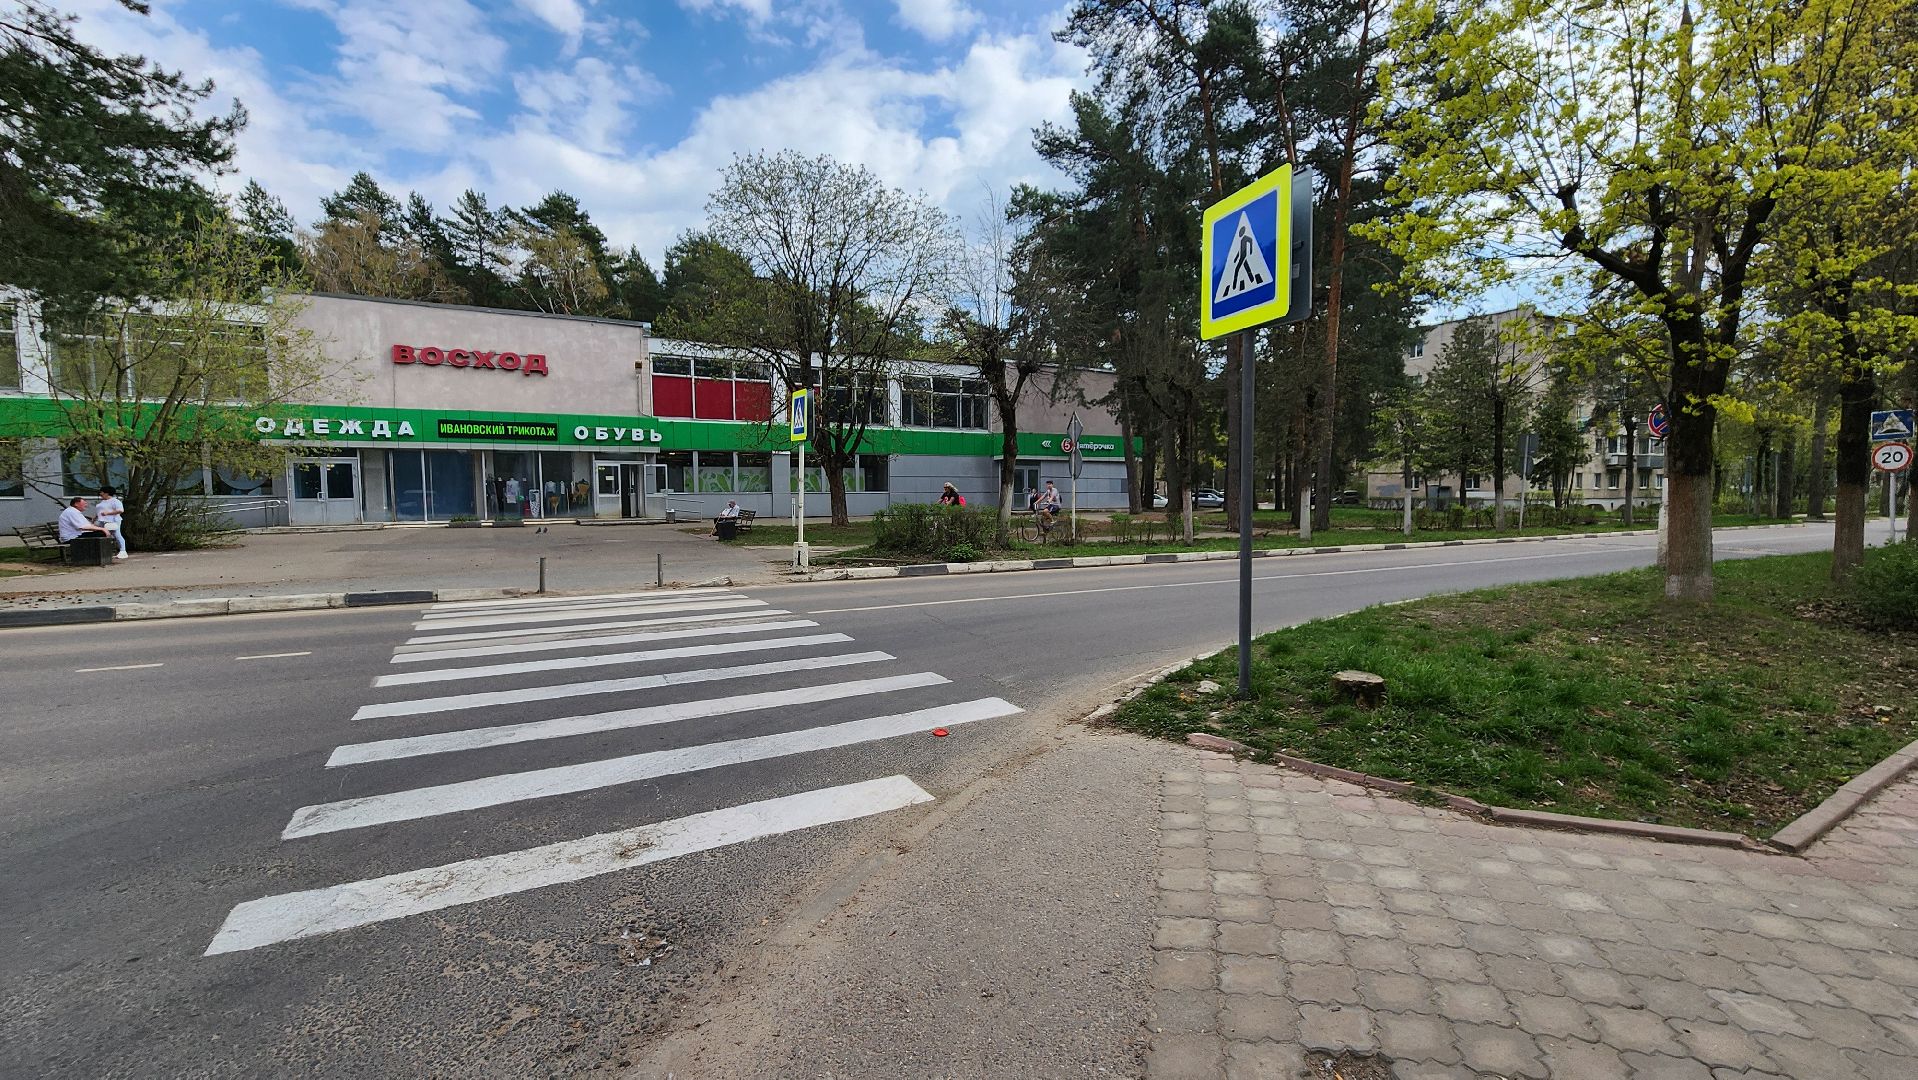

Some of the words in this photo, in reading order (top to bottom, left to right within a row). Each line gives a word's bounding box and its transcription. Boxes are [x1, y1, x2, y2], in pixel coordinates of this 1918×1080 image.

[392, 345, 548, 376] ВОСХОД
[255, 416, 415, 438] ОДЕЖДА
[440, 422, 505, 435] ИВАНОВСКИЙ
[507, 425, 556, 437] ТРИКОТАЖ
[574, 426, 662, 442] ОБУВЬ
[1881, 451, 1904, 464] 20
